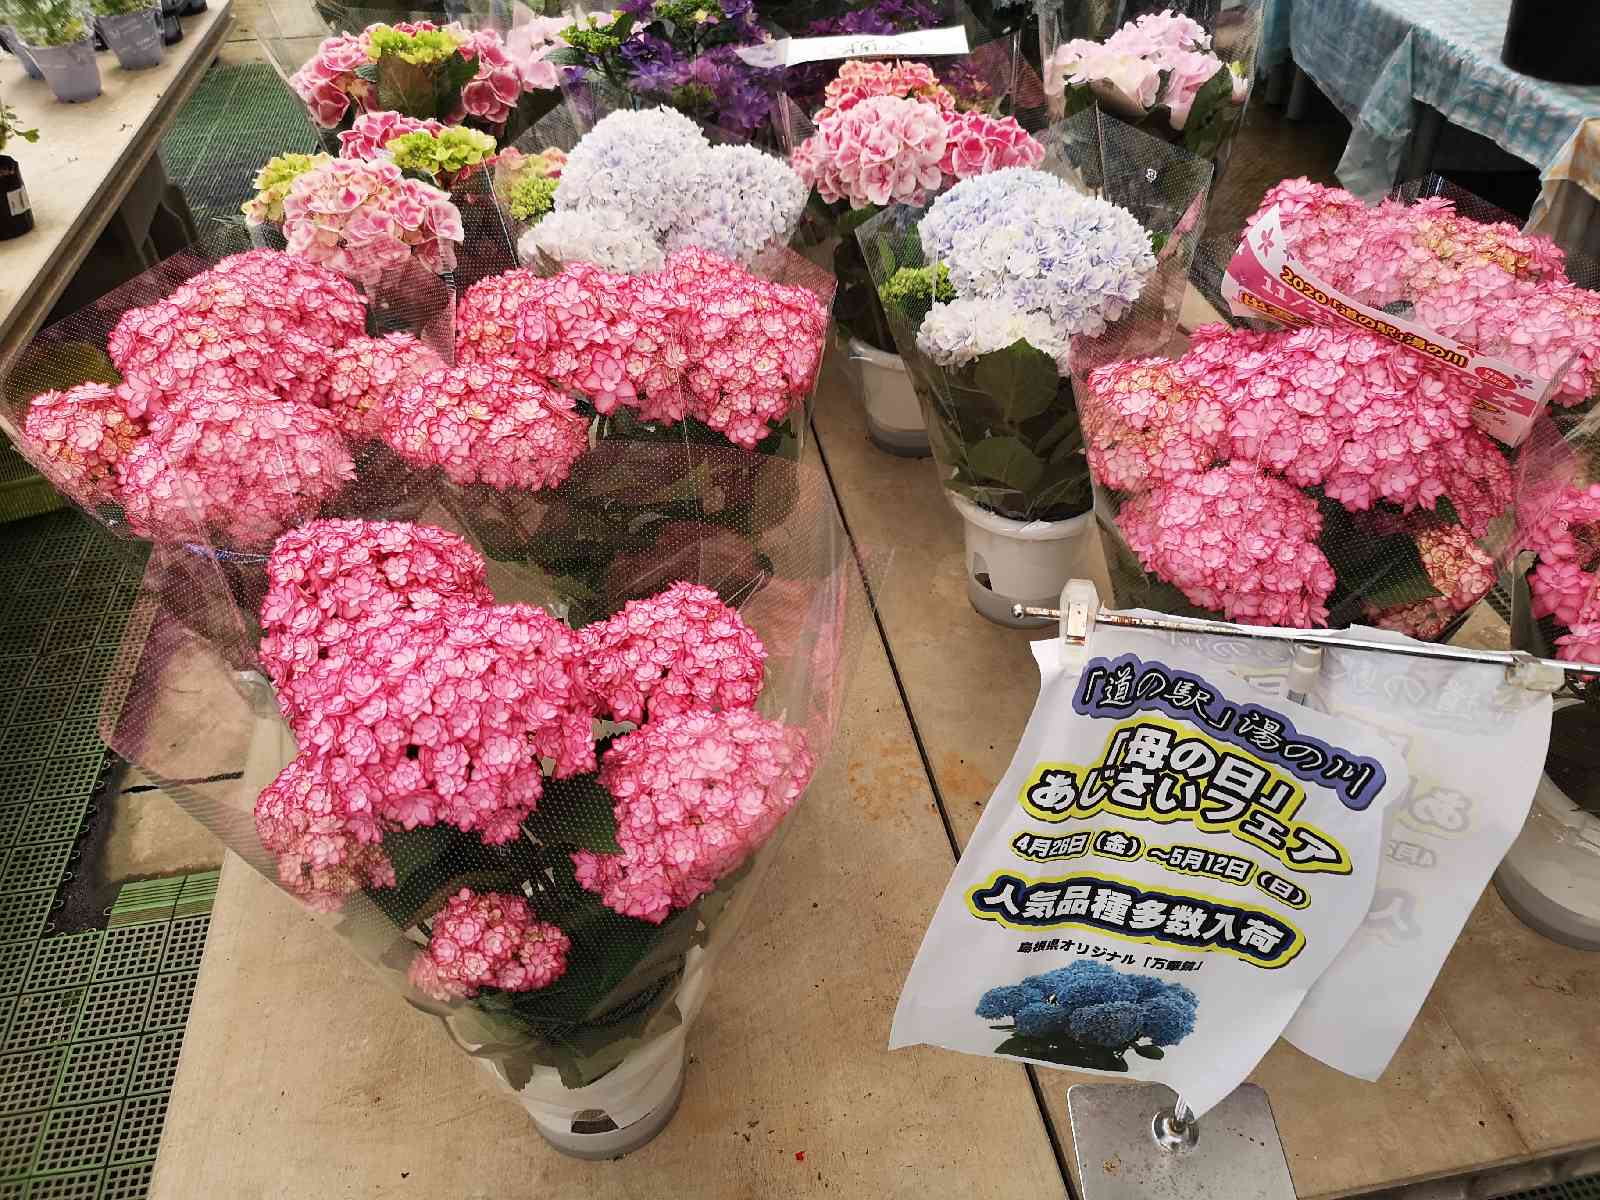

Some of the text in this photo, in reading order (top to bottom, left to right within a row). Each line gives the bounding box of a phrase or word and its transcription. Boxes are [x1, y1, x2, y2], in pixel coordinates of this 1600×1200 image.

[1103, 723, 1294, 813] 「母の日」
[1028, 764, 1341, 868] あじさいフェア
[982, 883, 1287, 955] 人気品種多数入荷
